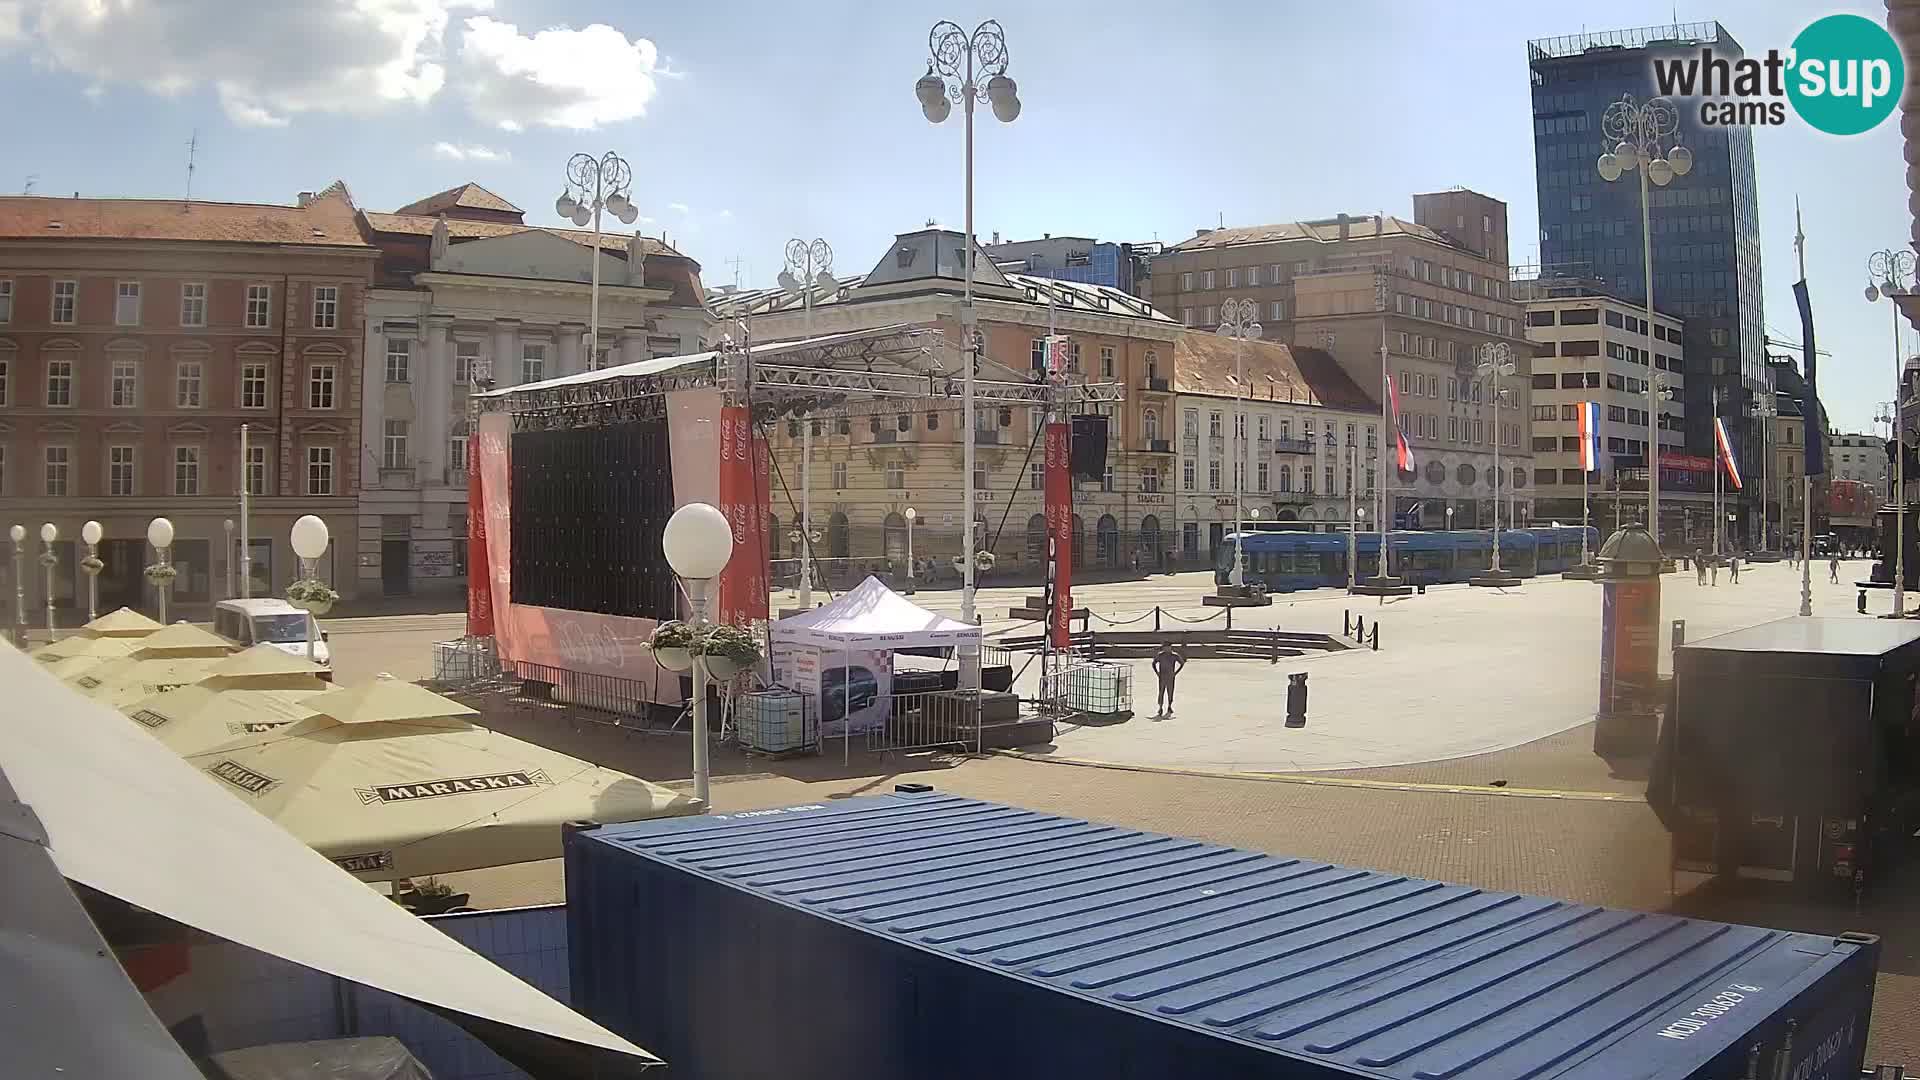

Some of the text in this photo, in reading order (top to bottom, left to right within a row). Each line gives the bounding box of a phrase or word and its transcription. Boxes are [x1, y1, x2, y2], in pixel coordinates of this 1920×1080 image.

[387, 774, 526, 800] MARASKA
[1656, 1017, 1708, 1039] MCDU
[1690, 991, 1745, 1020] 300629
